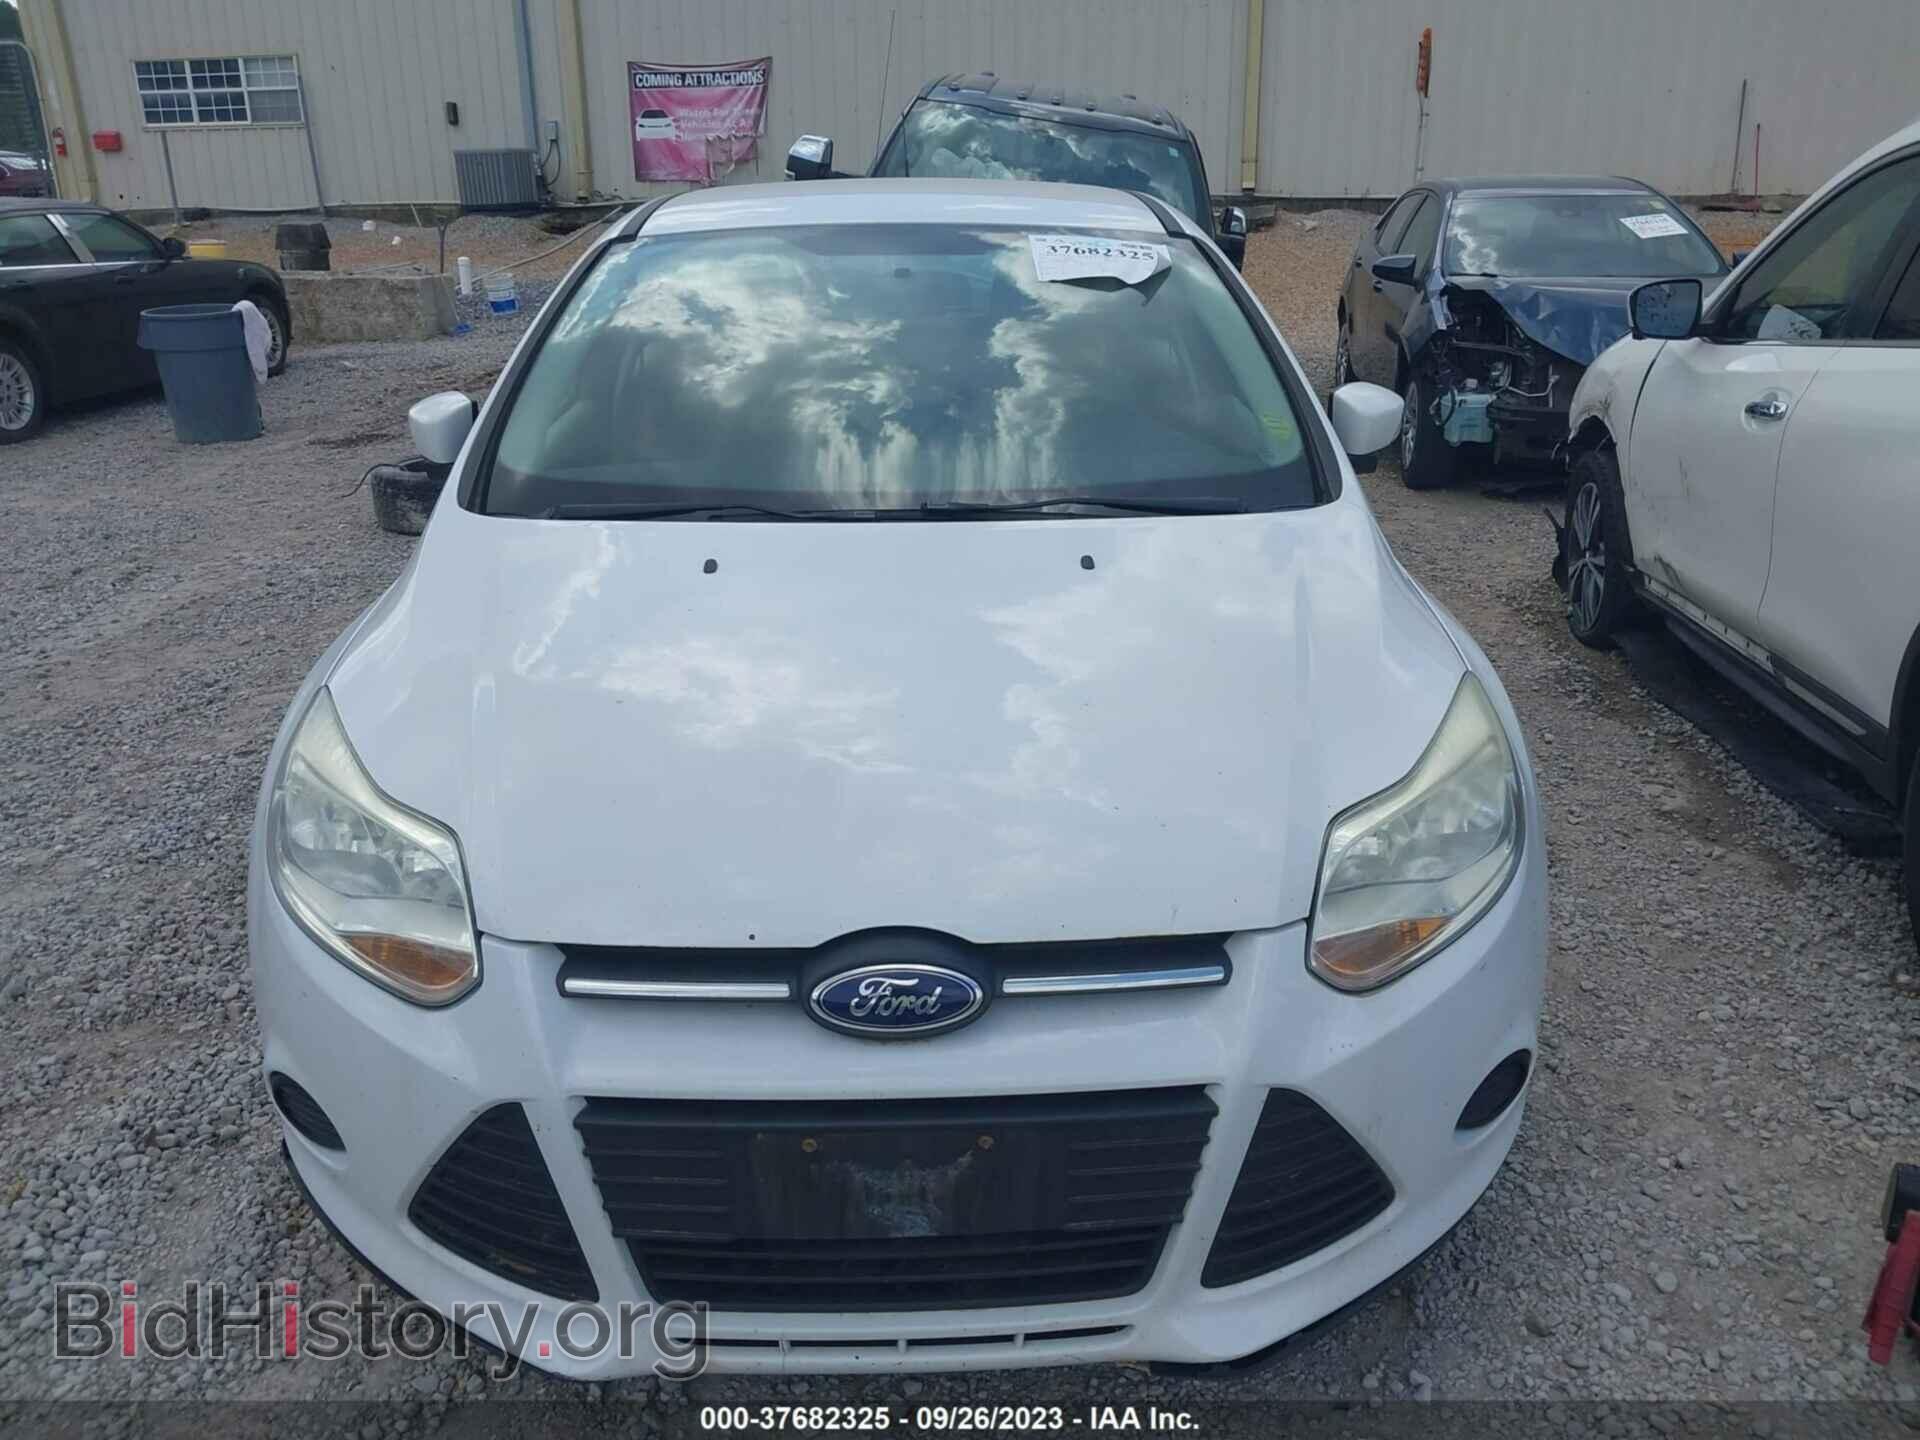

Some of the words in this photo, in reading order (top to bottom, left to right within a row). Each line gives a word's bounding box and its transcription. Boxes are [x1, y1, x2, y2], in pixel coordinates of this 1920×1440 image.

[635, 73, 682, 88] COMING
[684, 70, 764, 87] ATTRACTIONS
[1046, 244, 1155, 260] 37682325
[850, 977, 943, 1017] Ford
